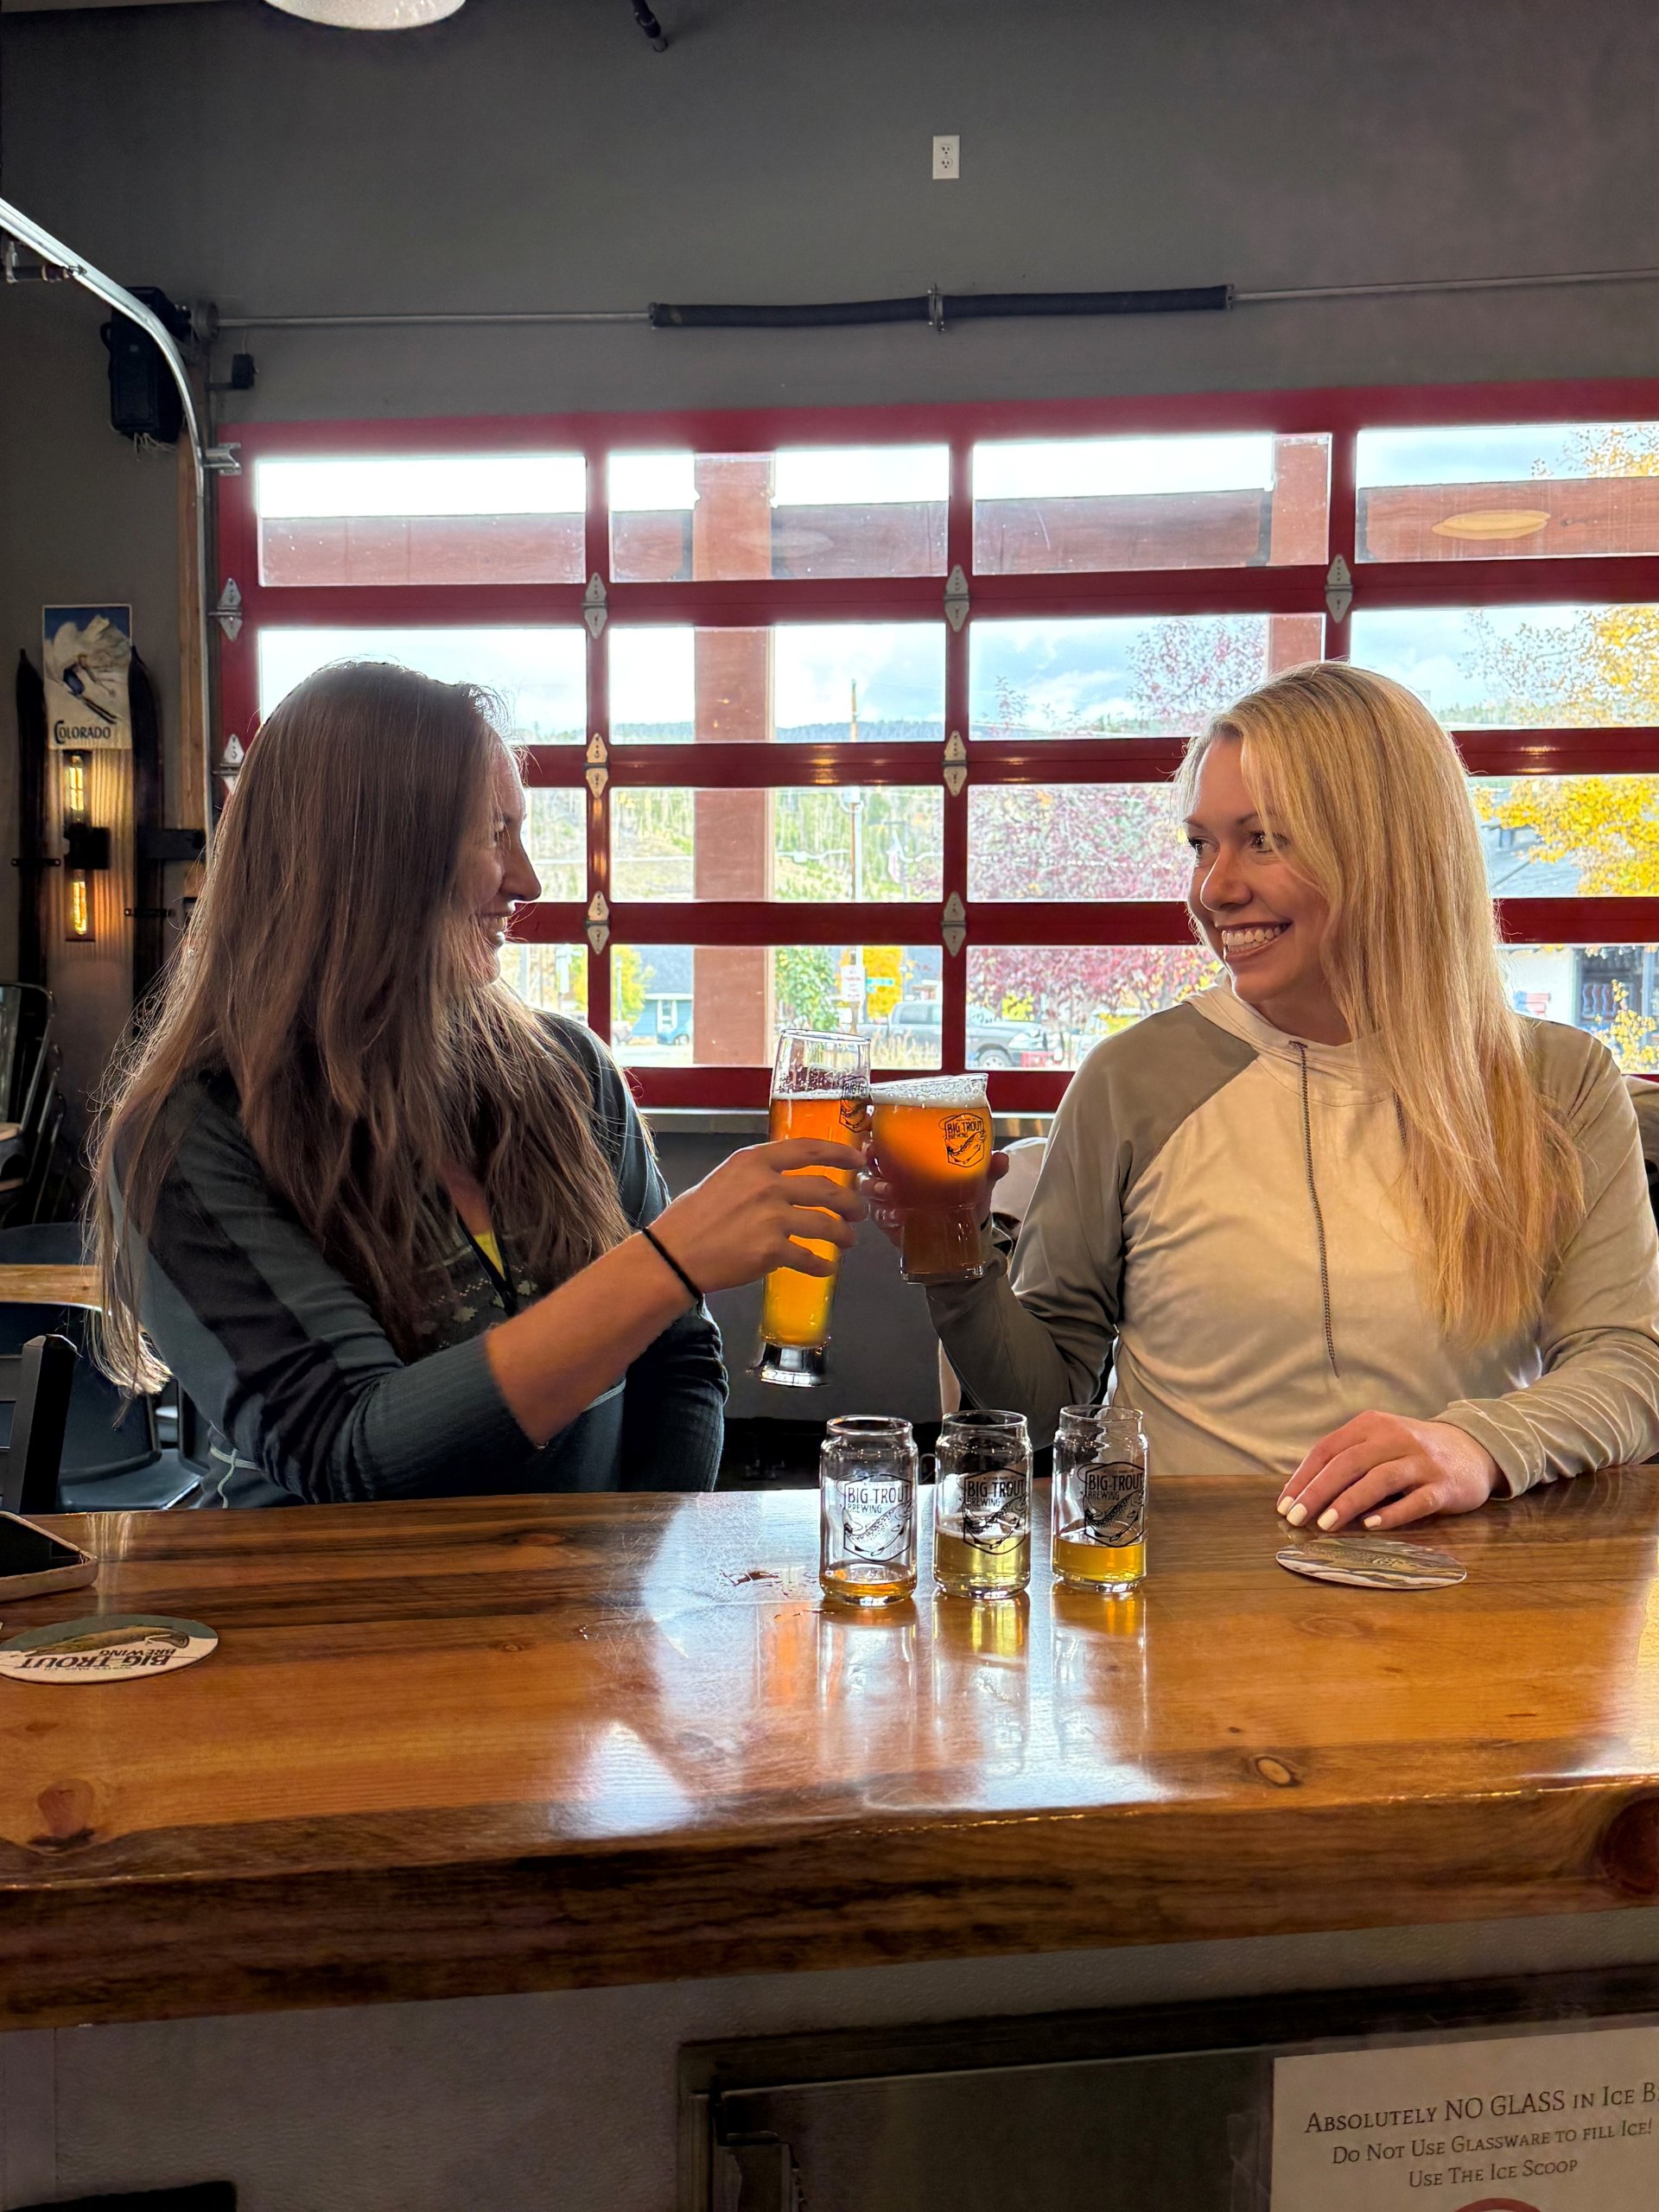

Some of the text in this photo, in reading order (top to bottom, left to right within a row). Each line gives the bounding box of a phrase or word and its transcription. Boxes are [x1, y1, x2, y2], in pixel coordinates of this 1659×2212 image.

[54, 720, 111, 744] COLORADO
[947, 1122, 960, 1133] BIG
[967, 1478, 1025, 1497] BIG TROUT
[1088, 1472, 1143, 1491] BIG TROUT
[848, 1485, 910, 1504] BIG TROUT
[1088, 1491, 1120, 1501] BREWING
[847, 1503, 882, 1514] BREWING
[967, 1497, 1001, 1507] BREWING
[15, 1656, 111, 1669] TROUT
[121, 1656, 172, 1667] BIG
[1445, 2097, 1484, 2120] NO
[1491, 2090, 1566, 2116] GLASS
